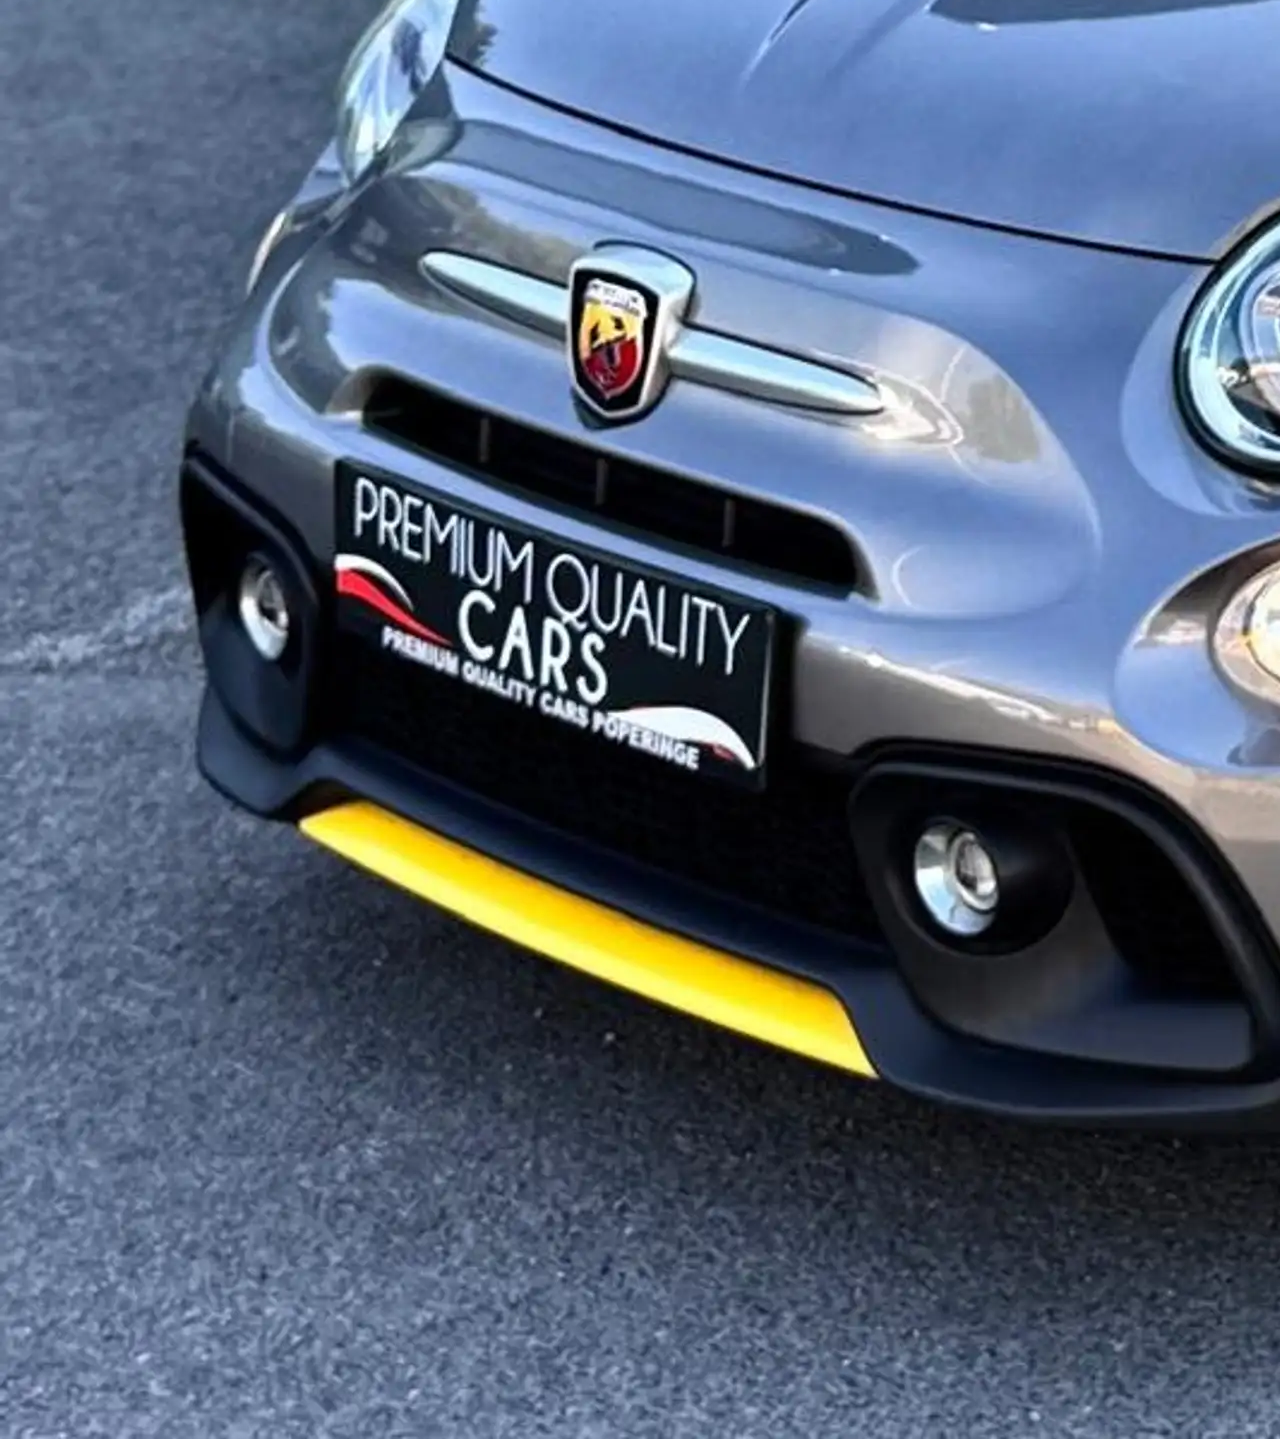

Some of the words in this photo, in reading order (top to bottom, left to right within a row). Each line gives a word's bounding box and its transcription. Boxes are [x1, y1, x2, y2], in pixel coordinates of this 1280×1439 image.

[354, 476, 535, 604] PREMIUM
[545, 553, 750, 676] QUALITY
[457, 589, 610, 705] CARS
[380, 625, 460, 674] PREMIUM
[461, 659, 538, 708] QUALITY
[538, 690, 591, 731] CARS
[592, 710, 700, 771] POPERINGE
